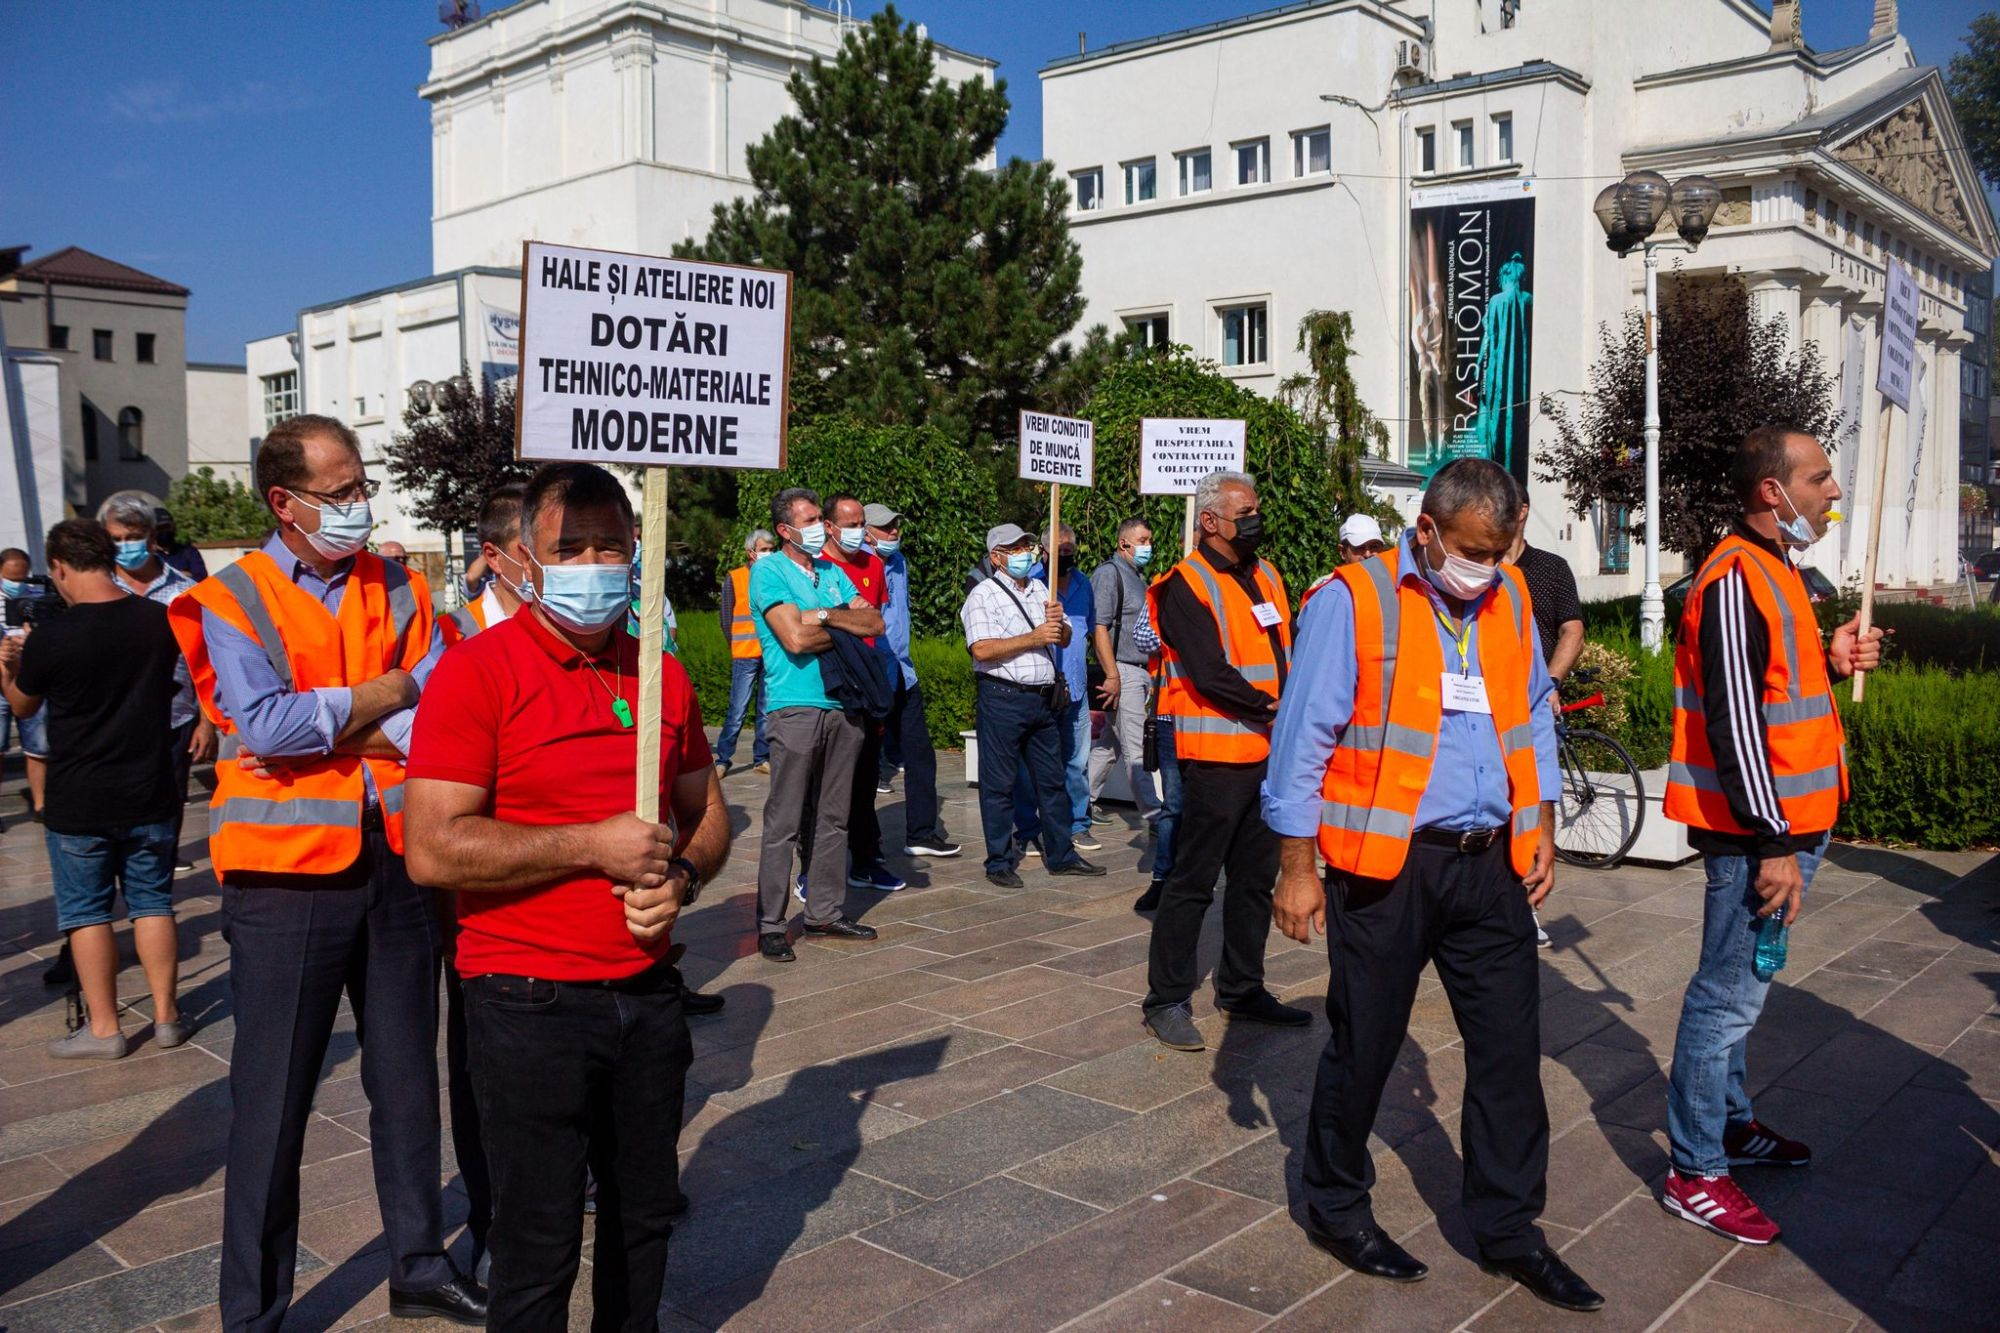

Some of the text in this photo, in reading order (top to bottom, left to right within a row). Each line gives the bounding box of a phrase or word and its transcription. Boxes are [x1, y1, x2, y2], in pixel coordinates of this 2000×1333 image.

[542, 256, 775, 310] HALE ȘI ATELIERE NOI
[591, 311, 728, 356] DOTĂRI
[539, 357, 771, 406] TEHNICO-MATERIALE
[571, 408, 738, 456] MODERNE
[1025, 414, 1090, 443] VREM CONDIȚII
[1178, 426, 1211, 435] VREM
[1029, 440, 1081, 461] DE MUNCĂ
[1155, 439, 1234, 448] RESPECTAREA
[1152, 452, 1235, 461] CONTRACTULUI
[1031, 458, 1082, 478] DECENTE
[1157, 465, 1210, 473] COLECTIV
